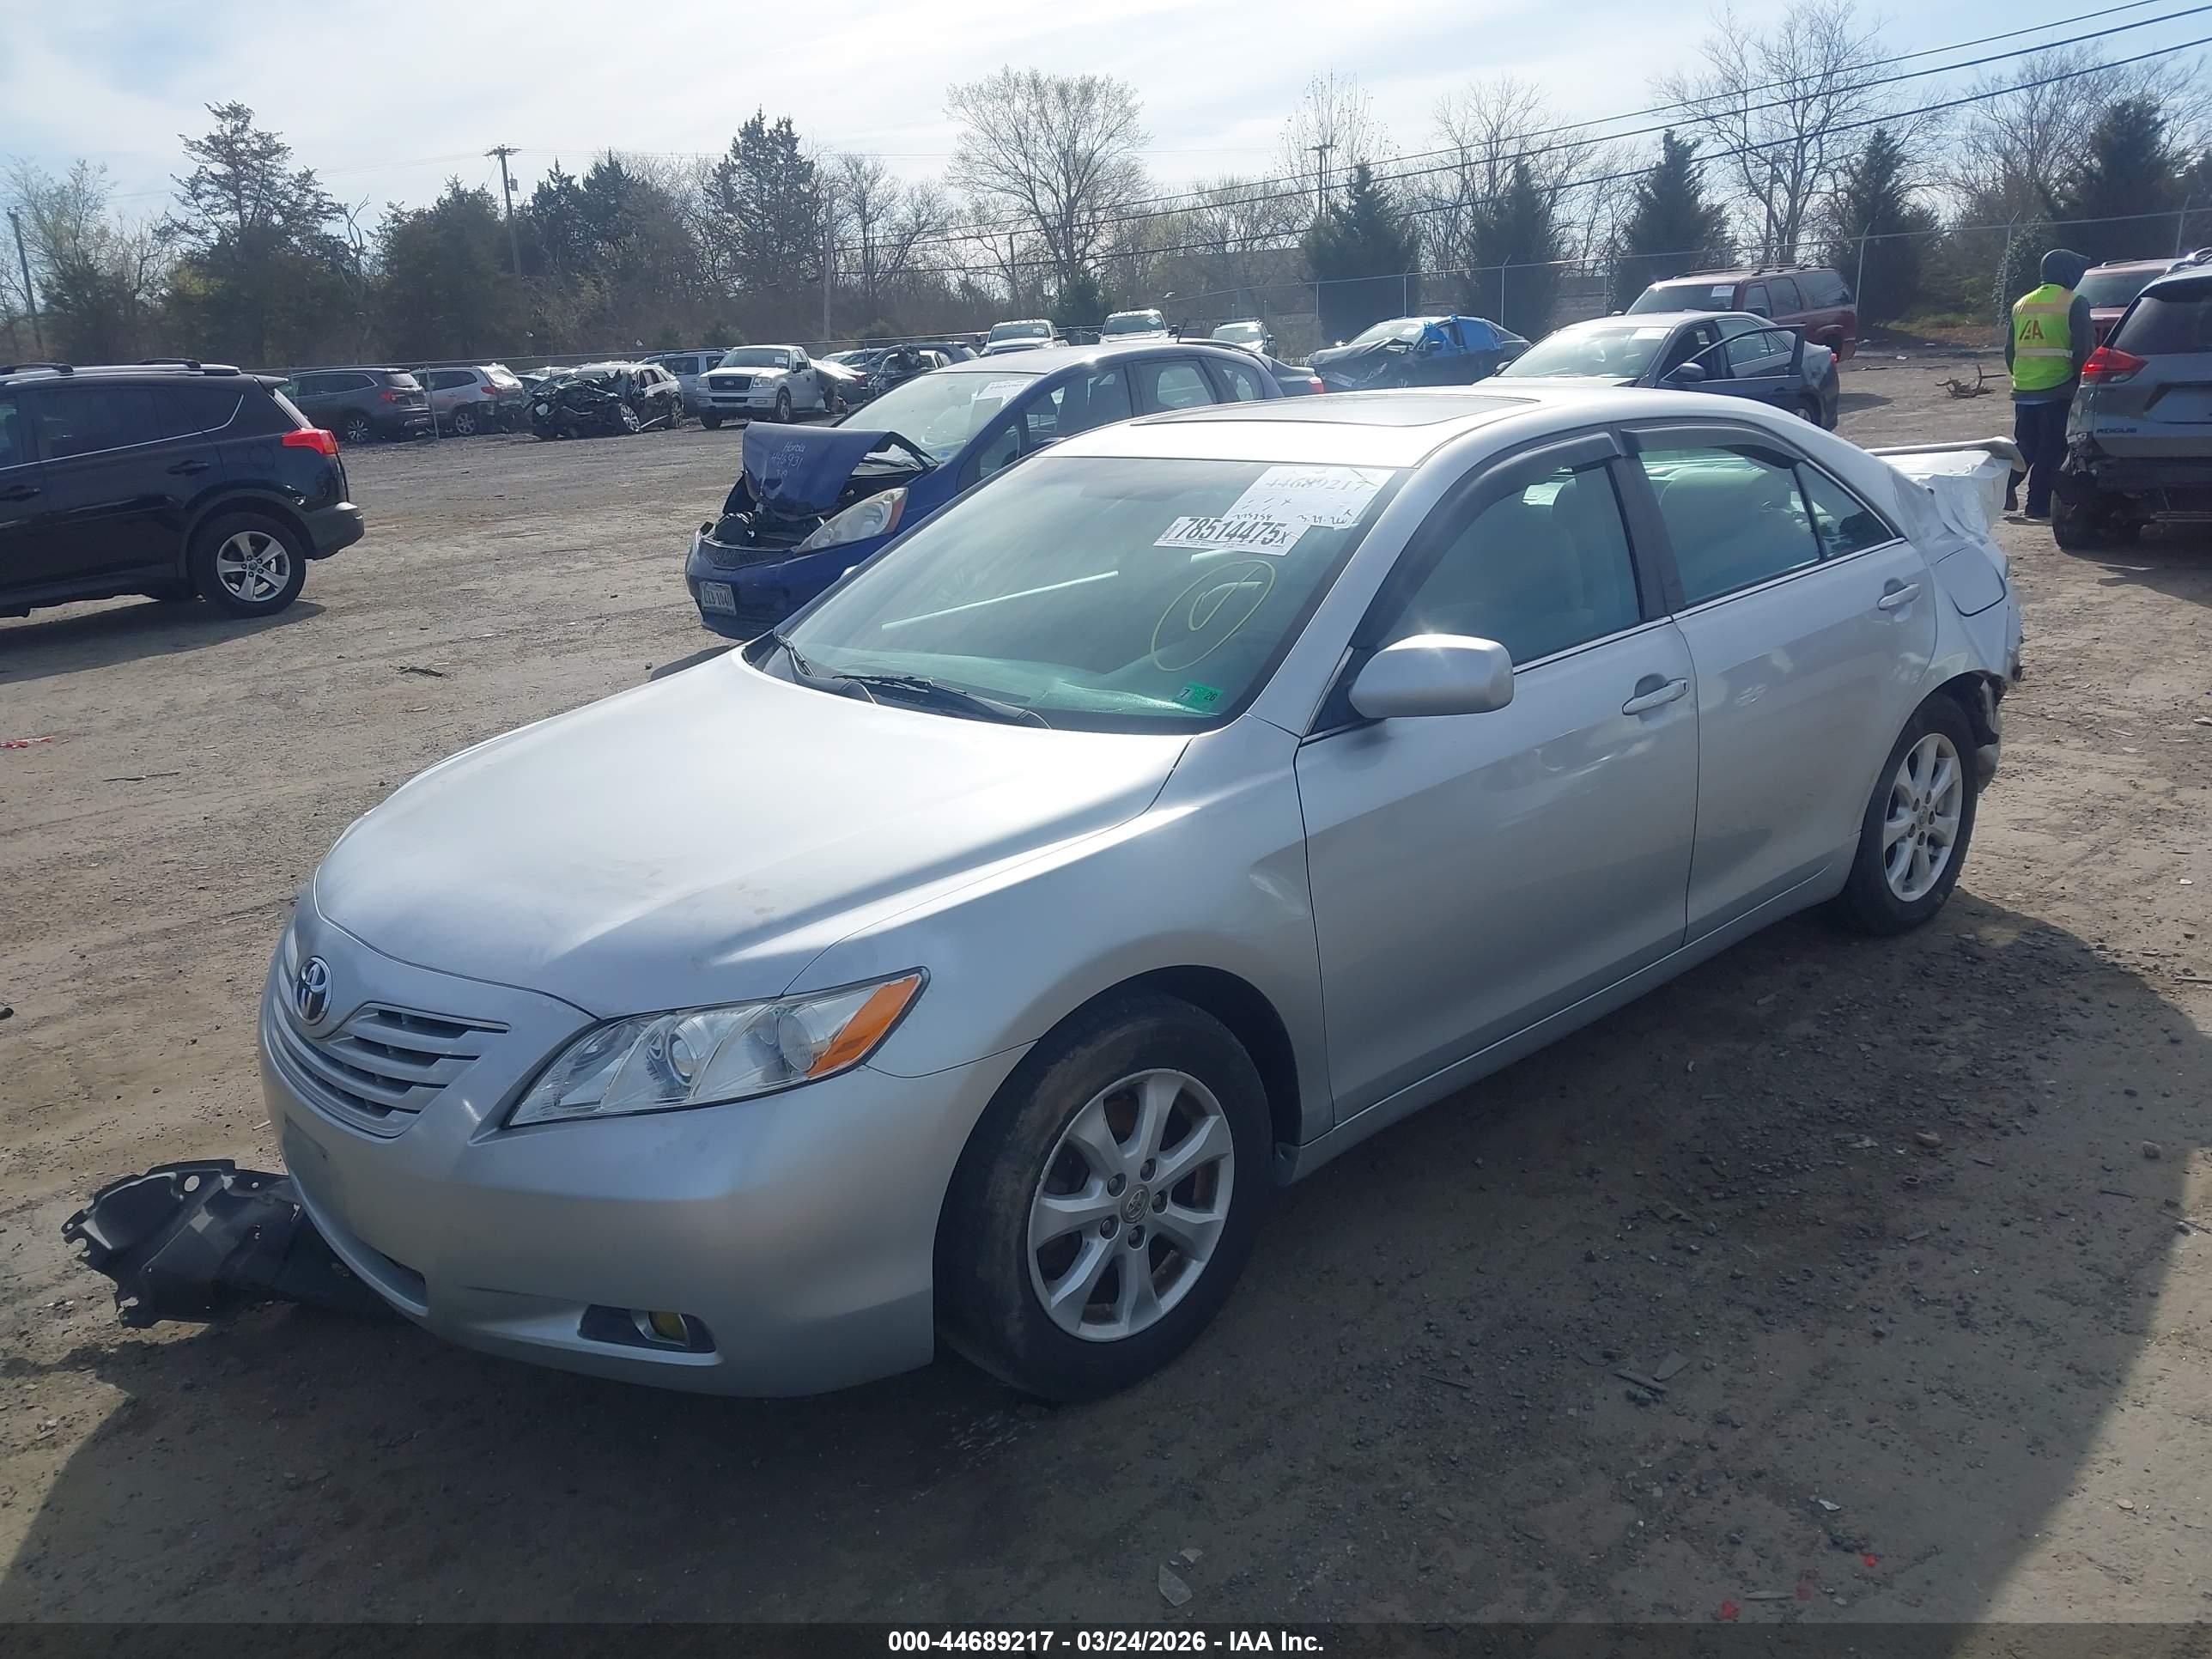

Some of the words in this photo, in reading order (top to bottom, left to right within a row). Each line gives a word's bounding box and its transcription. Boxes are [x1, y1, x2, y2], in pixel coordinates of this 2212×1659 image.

[782, 441, 805, 453] Honda
[1181, 689, 1190, 698] 7
[1204, 691, 1218, 702] 26
